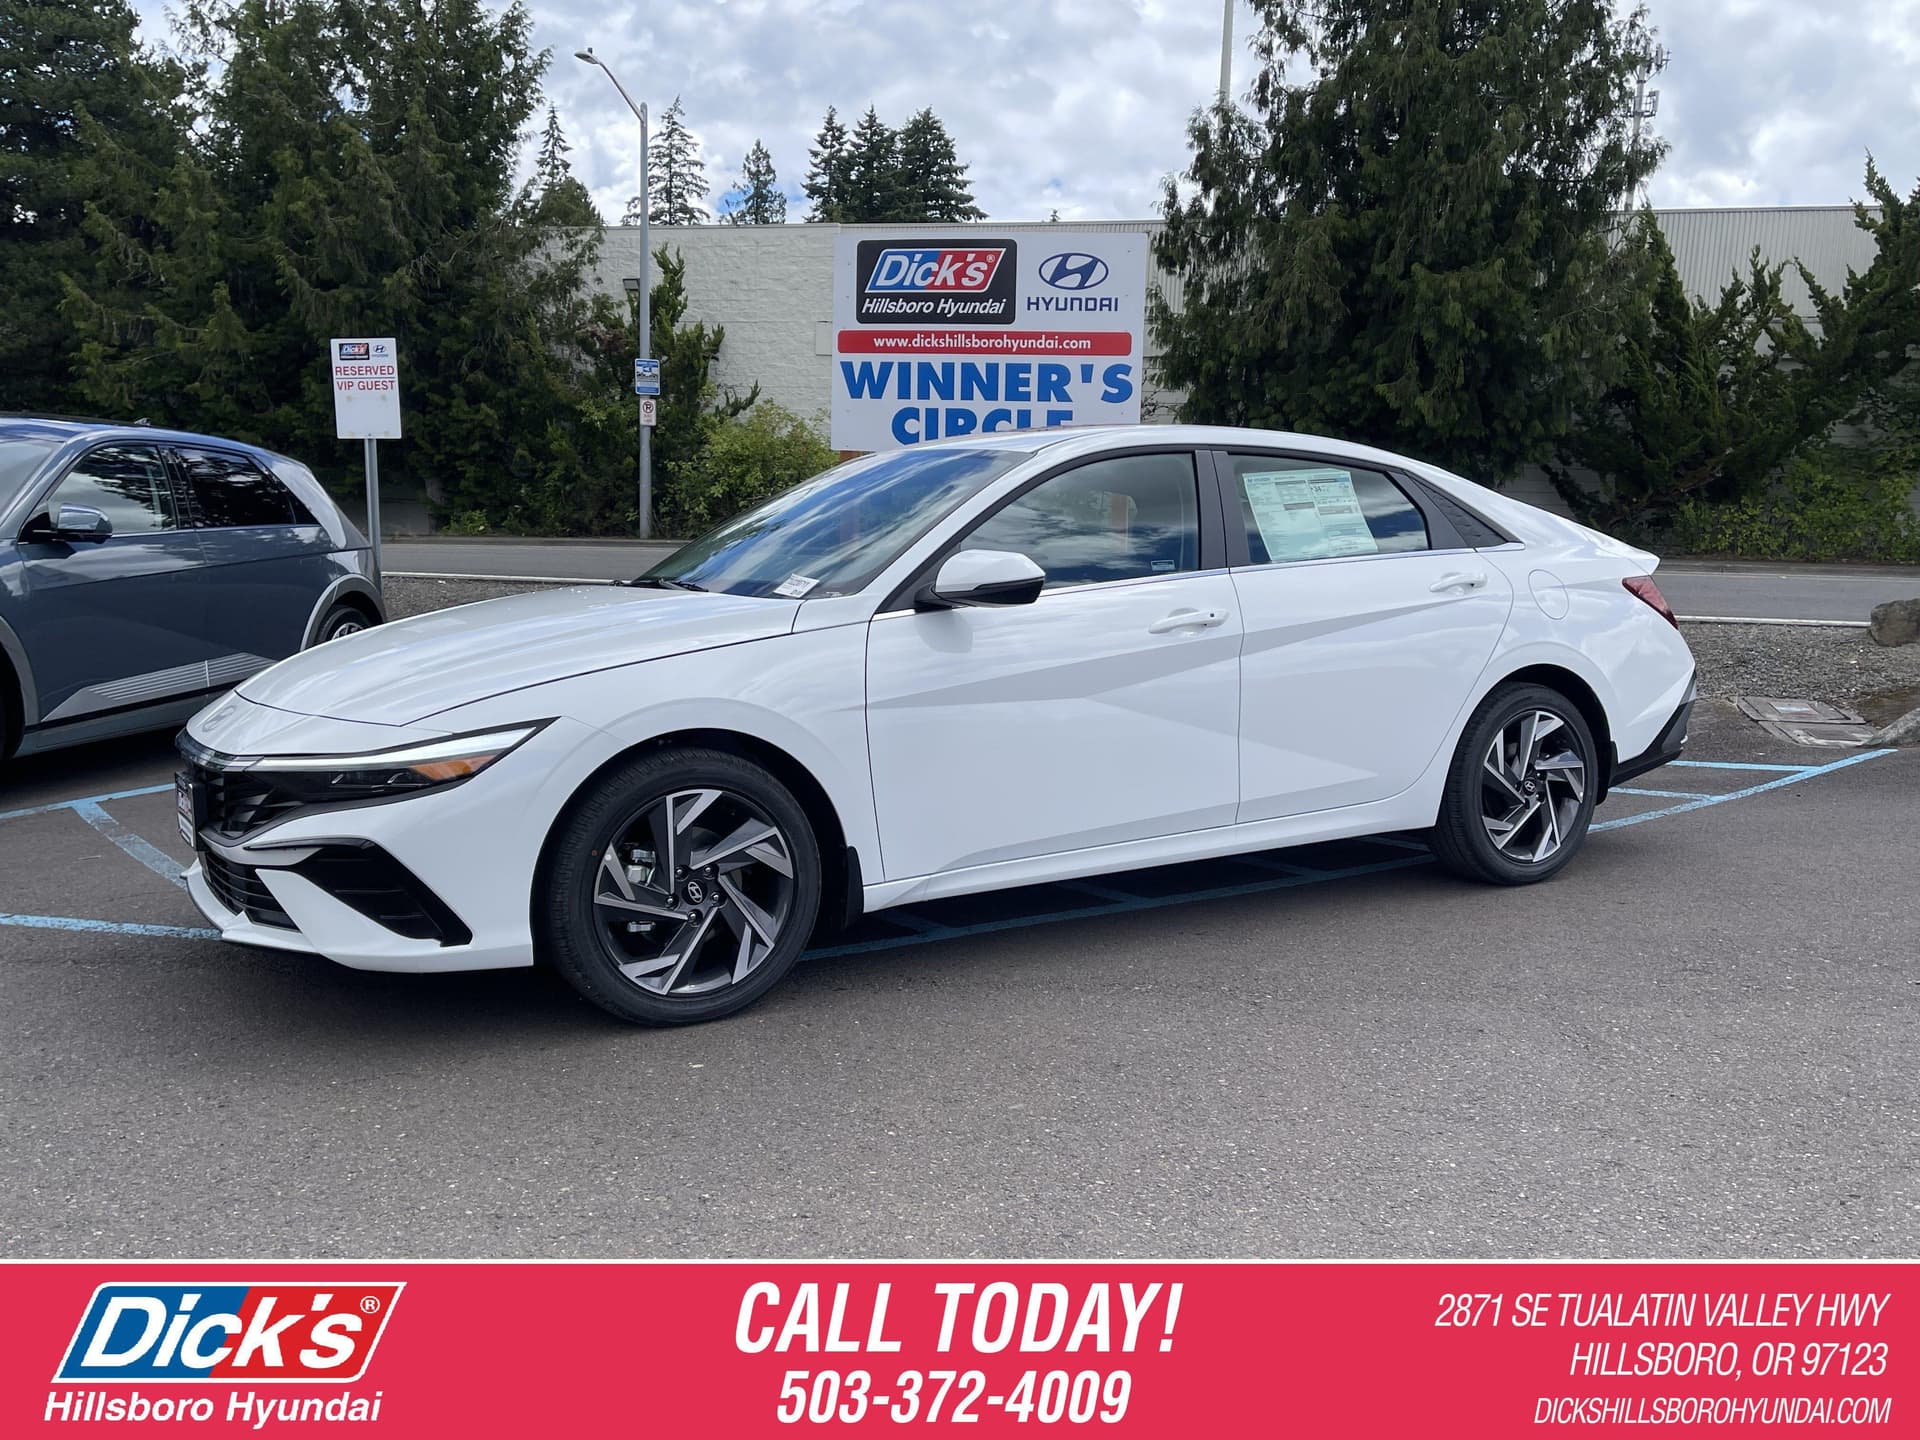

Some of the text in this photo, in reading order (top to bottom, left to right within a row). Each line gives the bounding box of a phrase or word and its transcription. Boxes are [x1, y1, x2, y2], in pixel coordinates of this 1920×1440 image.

[875, 253, 988, 287] Dick's
[861, 298, 1006, 317] Hillsboro Hyundai
[1026, 297, 1118, 312] HYUNDAI
[873, 334, 1091, 352] www.dickshillsborohyundai.com
[335, 366, 394, 376] RESERVED
[337, 381, 395, 391] VIP GUEST
[840, 361, 1133, 404] WINNER'S
